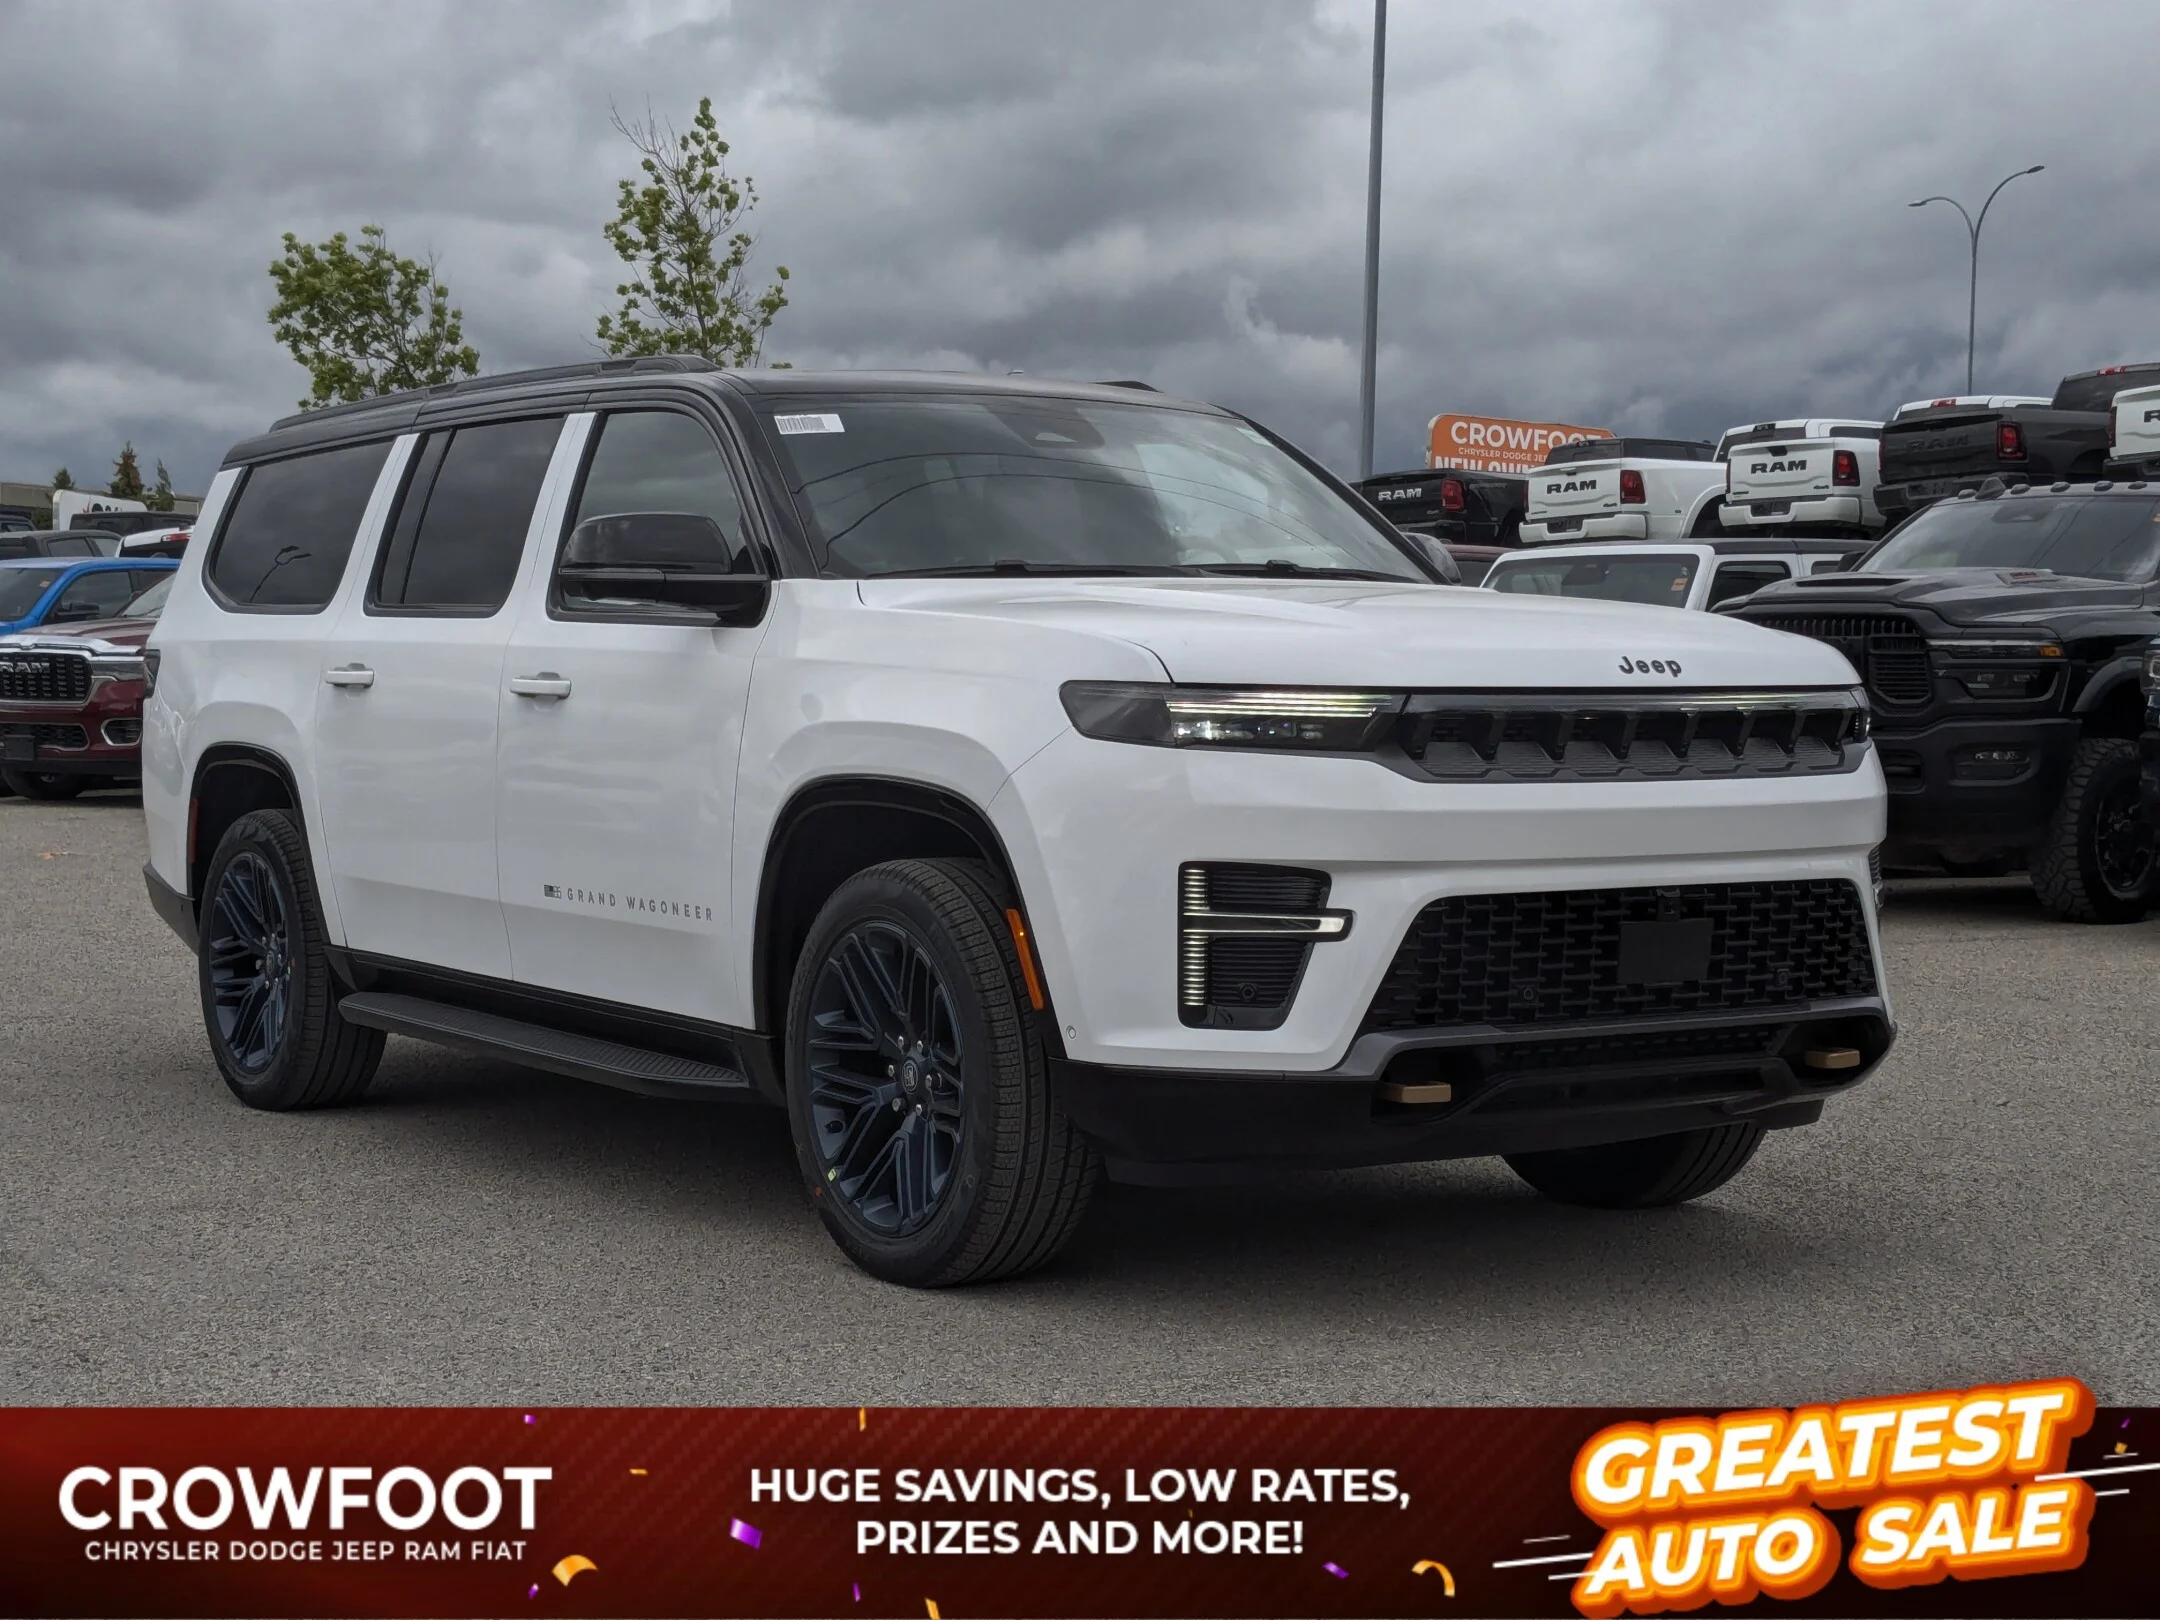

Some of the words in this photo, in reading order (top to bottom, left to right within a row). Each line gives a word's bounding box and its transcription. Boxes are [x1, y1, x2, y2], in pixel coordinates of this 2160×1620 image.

[1451, 421, 1602, 452] CROWFO
[1458, 447, 1501, 459] CHRYSLER
[1503, 451, 1532, 462] DODGE
[1750, 460, 1807, 474] RAM
[1546, 479, 1597, 494] RAM
[1378, 488, 1422, 501] RAM
[1618, 655, 1682, 678] Jeep
[567, 887, 616, 907] GRAND
[626, 896, 712, 922] WAGONEER
